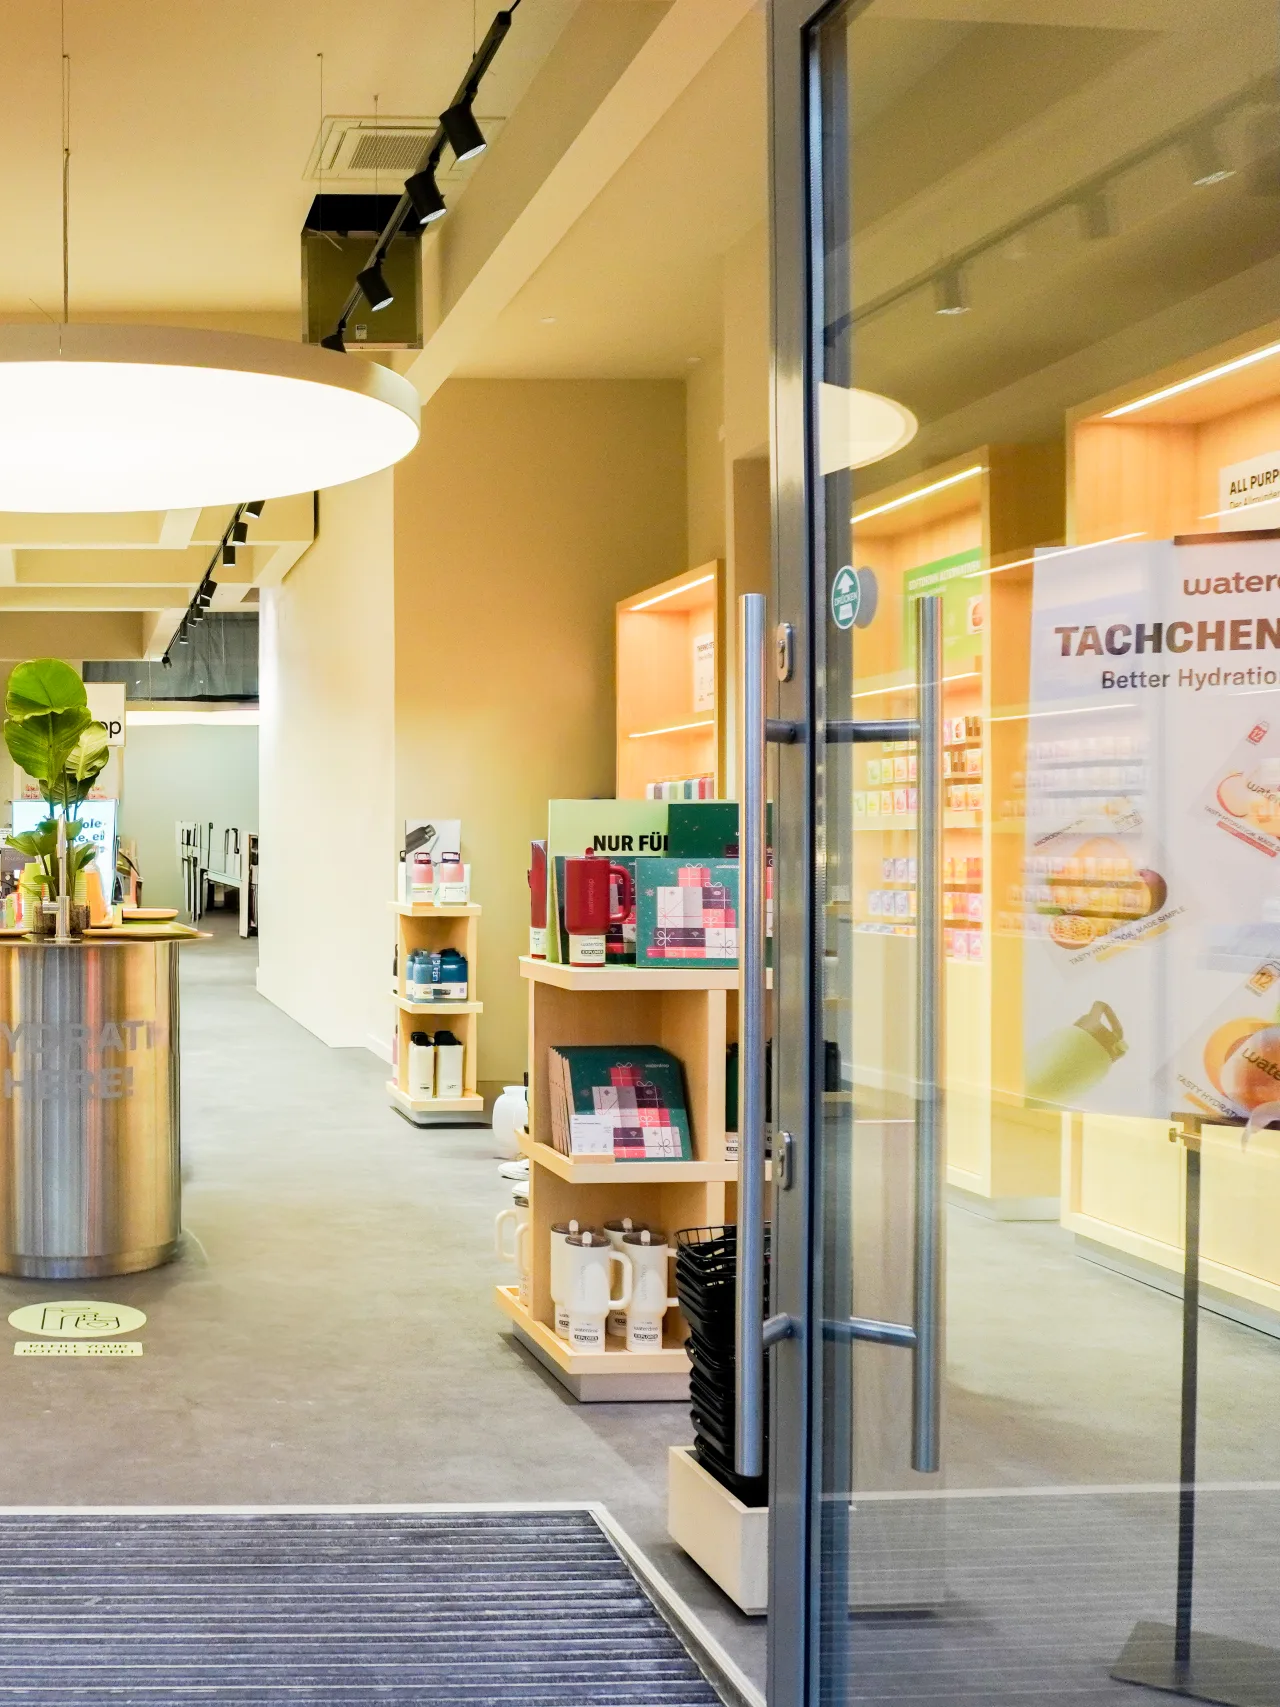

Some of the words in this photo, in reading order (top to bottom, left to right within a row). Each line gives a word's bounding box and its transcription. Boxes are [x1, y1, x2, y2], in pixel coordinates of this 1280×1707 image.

[1229, 478, 1247, 495] ALL
[1250, 468, 1280, 489] PURP
[1183, 571, 1280, 596] water
[1102, 670, 1170, 690] Better
[1178, 666, 1280, 692] Hydratio
[593, 834, 634, 852] NUR
[1136, 918, 1159, 934] MADE
[3, 1066, 134, 1099] HERE!
[1176, 1073, 1203, 1097] TASTY
